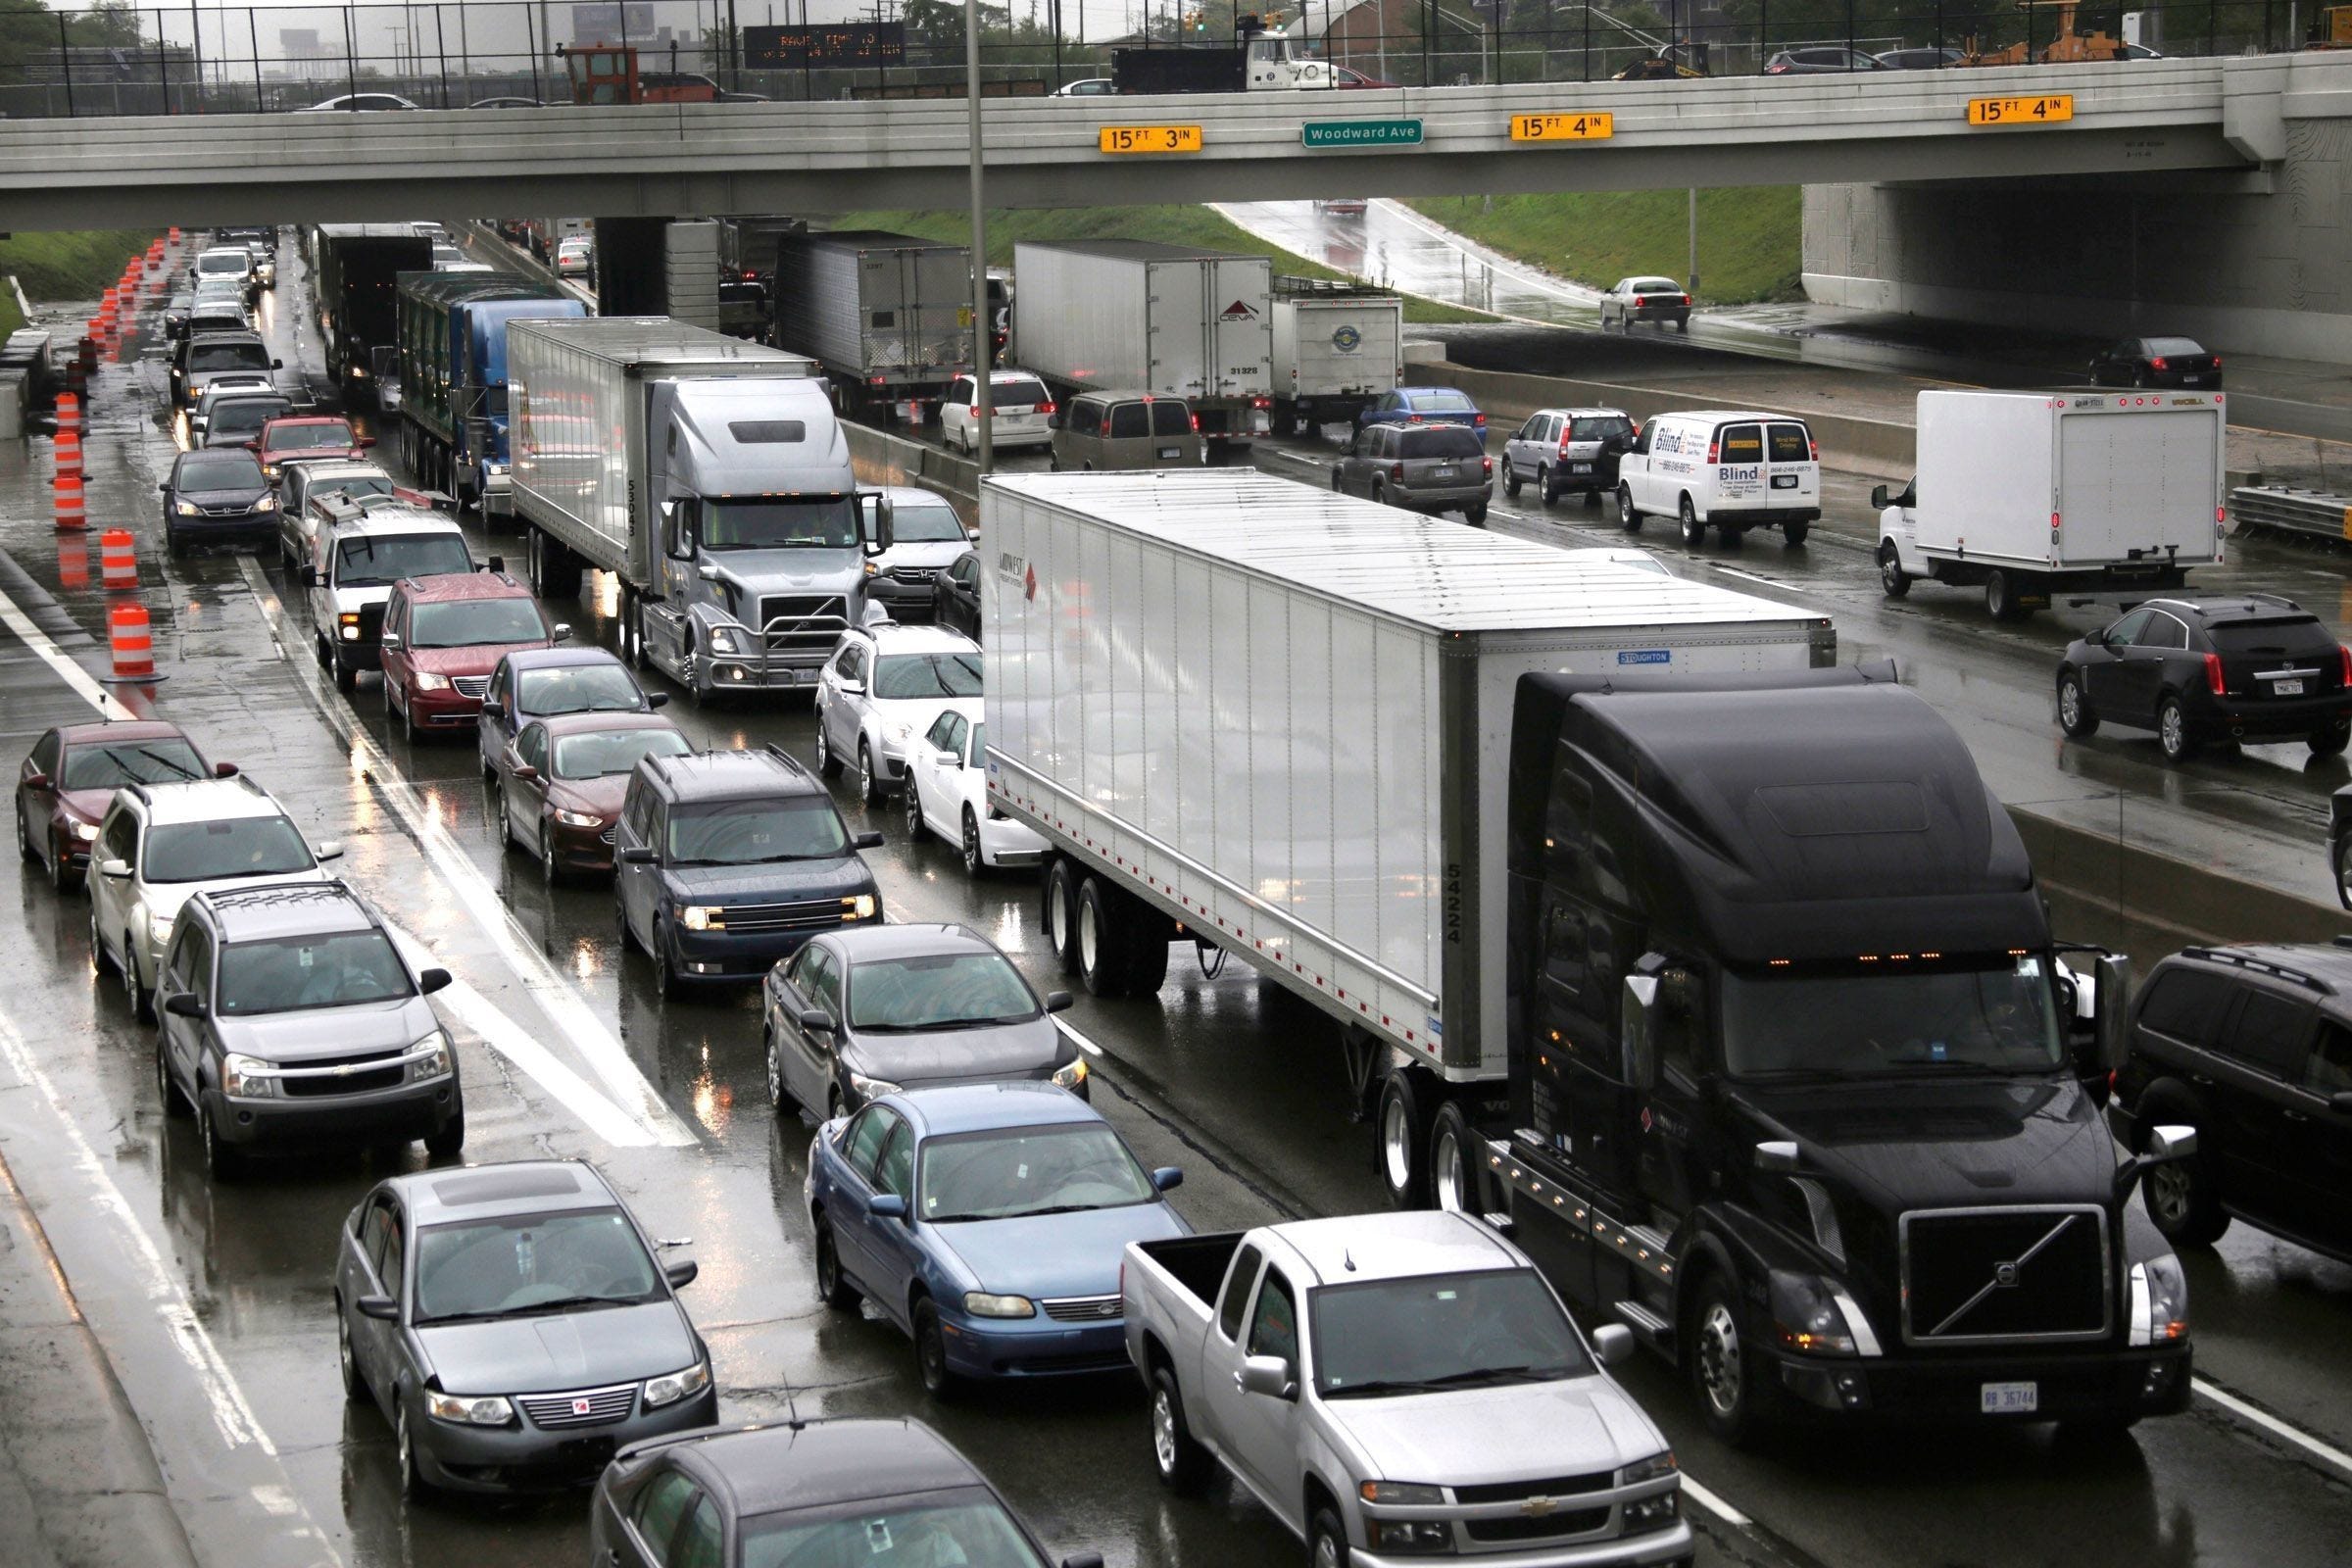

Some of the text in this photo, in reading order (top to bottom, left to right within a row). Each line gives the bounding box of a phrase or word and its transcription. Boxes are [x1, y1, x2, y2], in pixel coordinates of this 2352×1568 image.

[1981, 99, 2061, 122] 15 FT 4 IN
[1311, 126, 1416, 139] Woodward Ave
[1523, 117, 1601, 137] 15 FT 4 IN
[1111, 129, 1190, 149] 15 FT 3 IN
[1231, 367, 1258, 375] 31328
[1655, 427, 1685, 454] Blind
[1719, 466, 1758, 481] Blind
[1619, 651, 1668, 663] STOUGHTON
[1446, 863, 1461, 945] 54224
